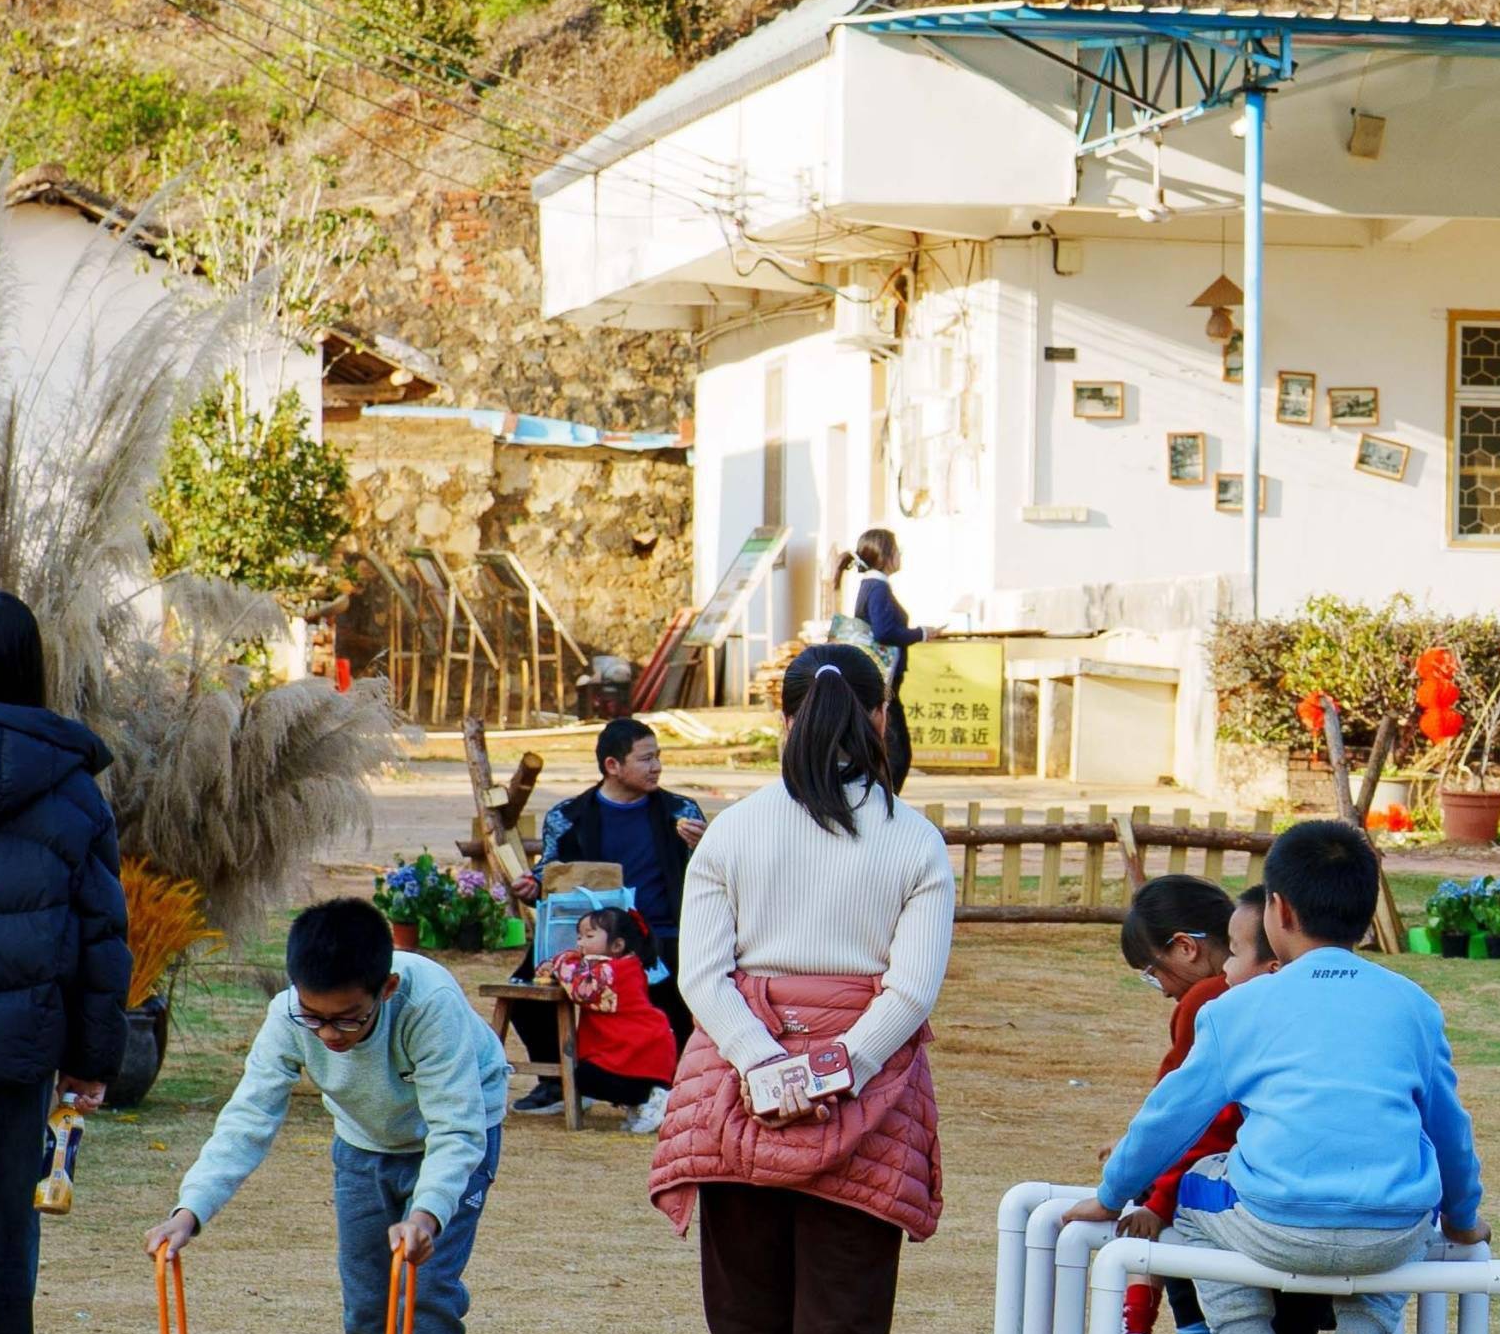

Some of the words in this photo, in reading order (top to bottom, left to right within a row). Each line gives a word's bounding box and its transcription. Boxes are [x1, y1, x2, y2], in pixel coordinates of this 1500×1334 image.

[907, 702, 990, 721] 水深危险
[909, 726, 989, 745] 请勿靠近
[1311, 969, 1359, 979] HAPPY
